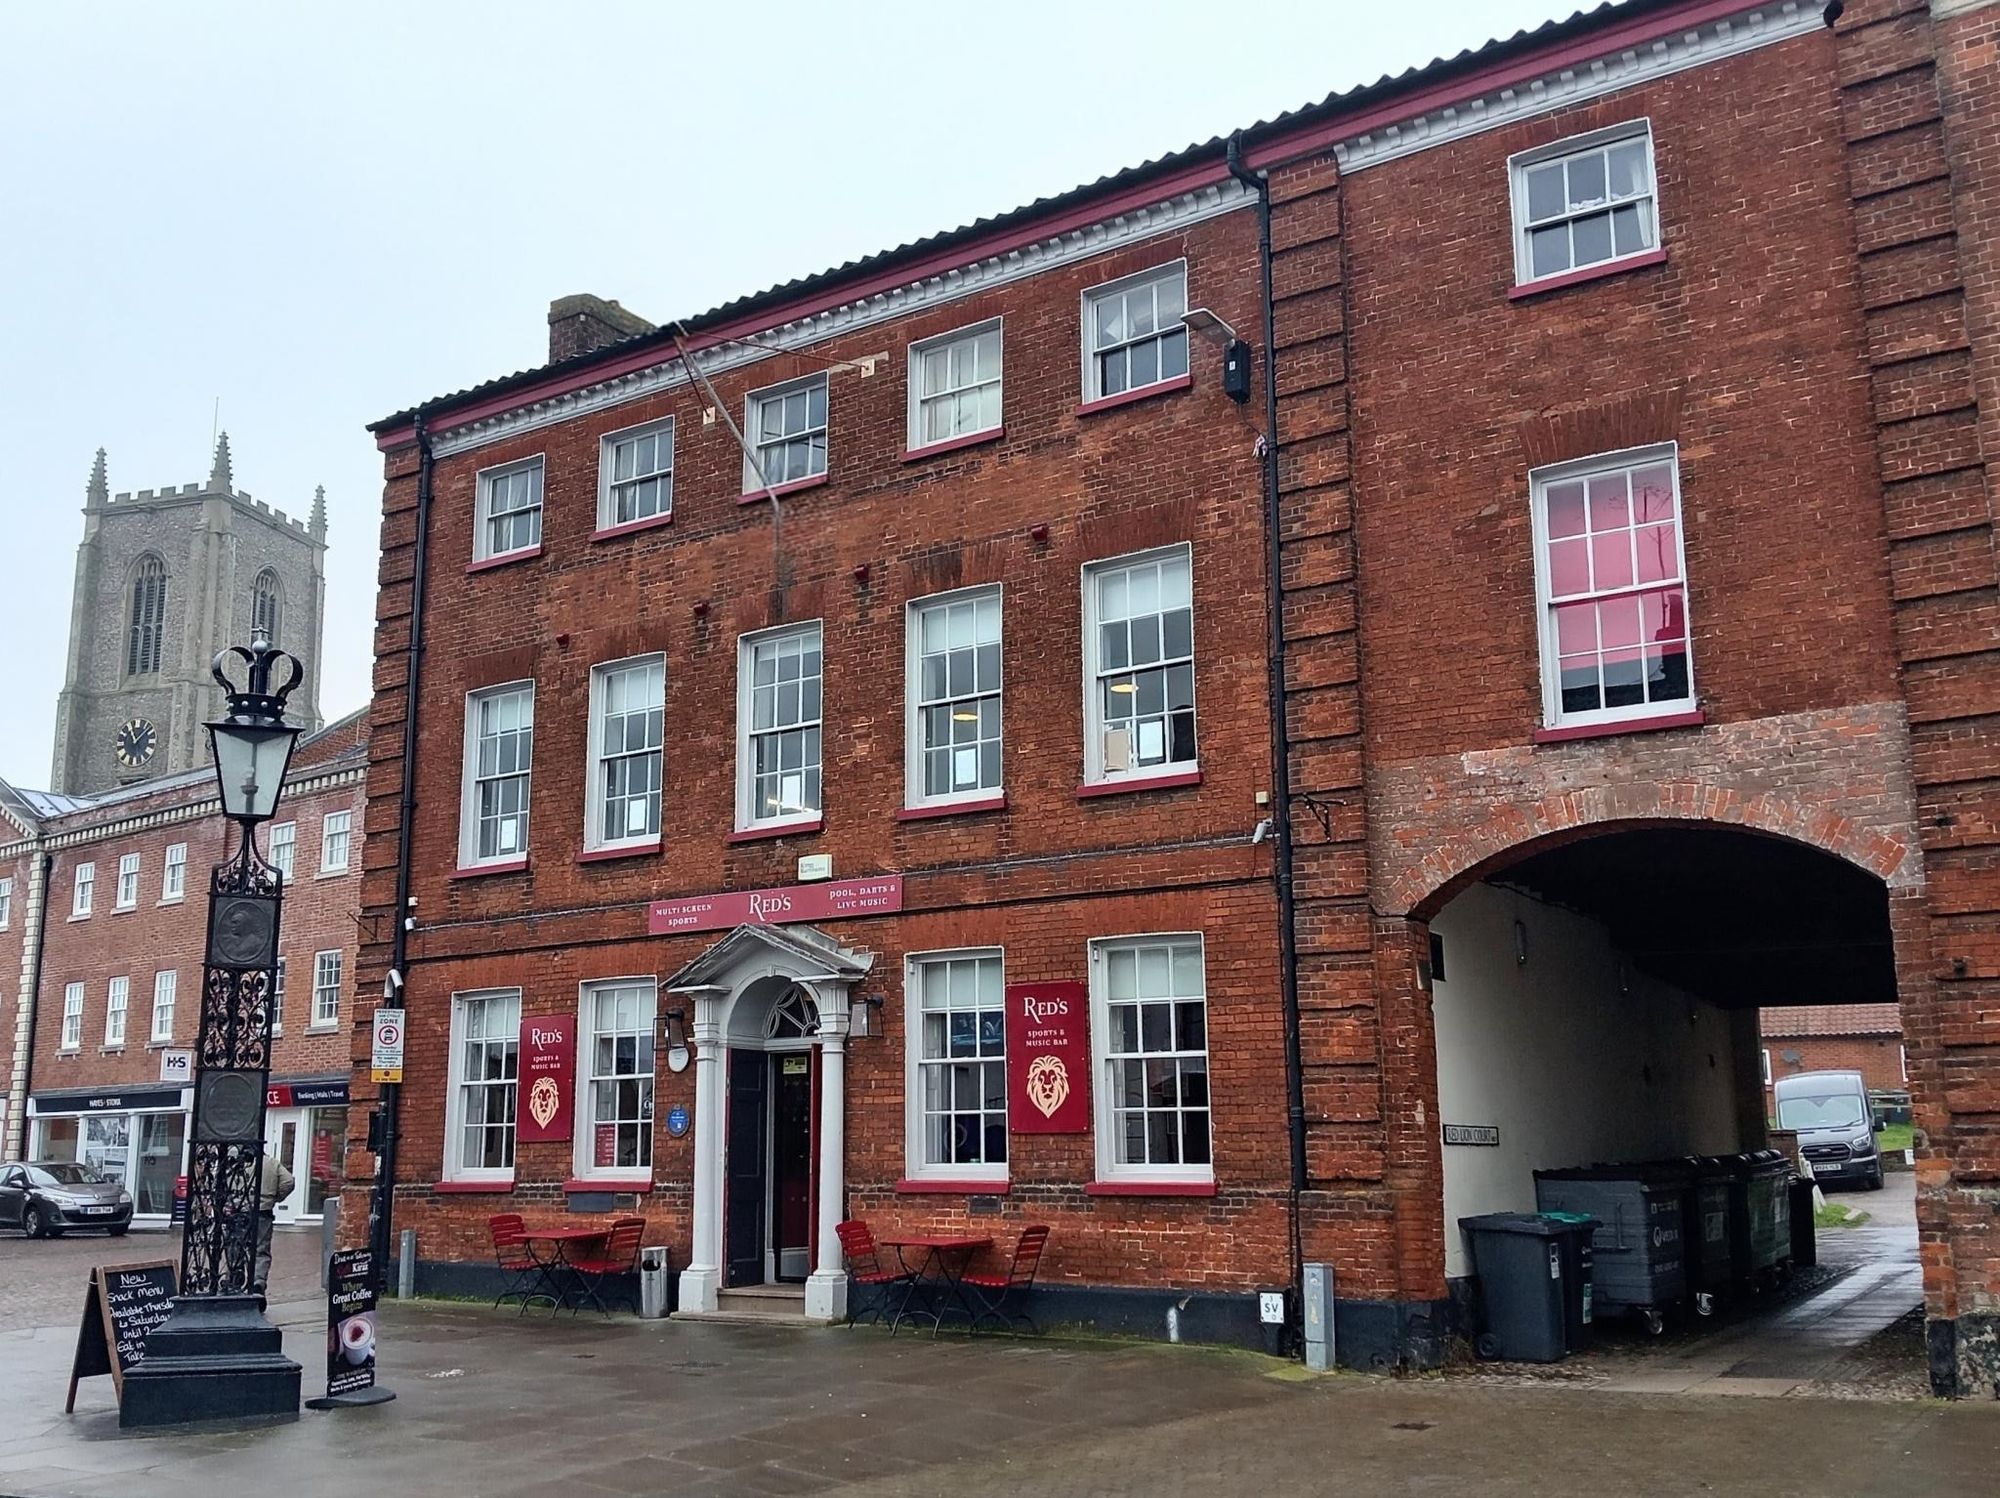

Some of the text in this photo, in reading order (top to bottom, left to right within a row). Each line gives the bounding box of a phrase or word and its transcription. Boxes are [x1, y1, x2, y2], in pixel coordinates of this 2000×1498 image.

[830, 889, 856, 900] POOL,
[860, 885, 888, 896] DARTS
[749, 894, 791, 921] RED'S
[837, 898, 888, 909] LIVE MUSIC
[656, 904, 712, 916] MULTI SCREEN
[668, 916, 698, 927] SPORTS
[1024, 997, 1068, 1024] RED'S
[531, 1028, 562, 1051] RED'S
[1028, 1030, 1058, 1038] SPORTS
[1026, 1038, 1068, 1046] MUSIC BAR
[121, 1274, 147, 1285] New
[107, 1290, 134, 1303] Snack
[332, 1288, 372, 1304] Great Coffee
[110, 1298, 174, 1319] Available Thursda
[1265, 1303, 1278, 1313] SV
[117, 1341, 135, 1352] Eat
